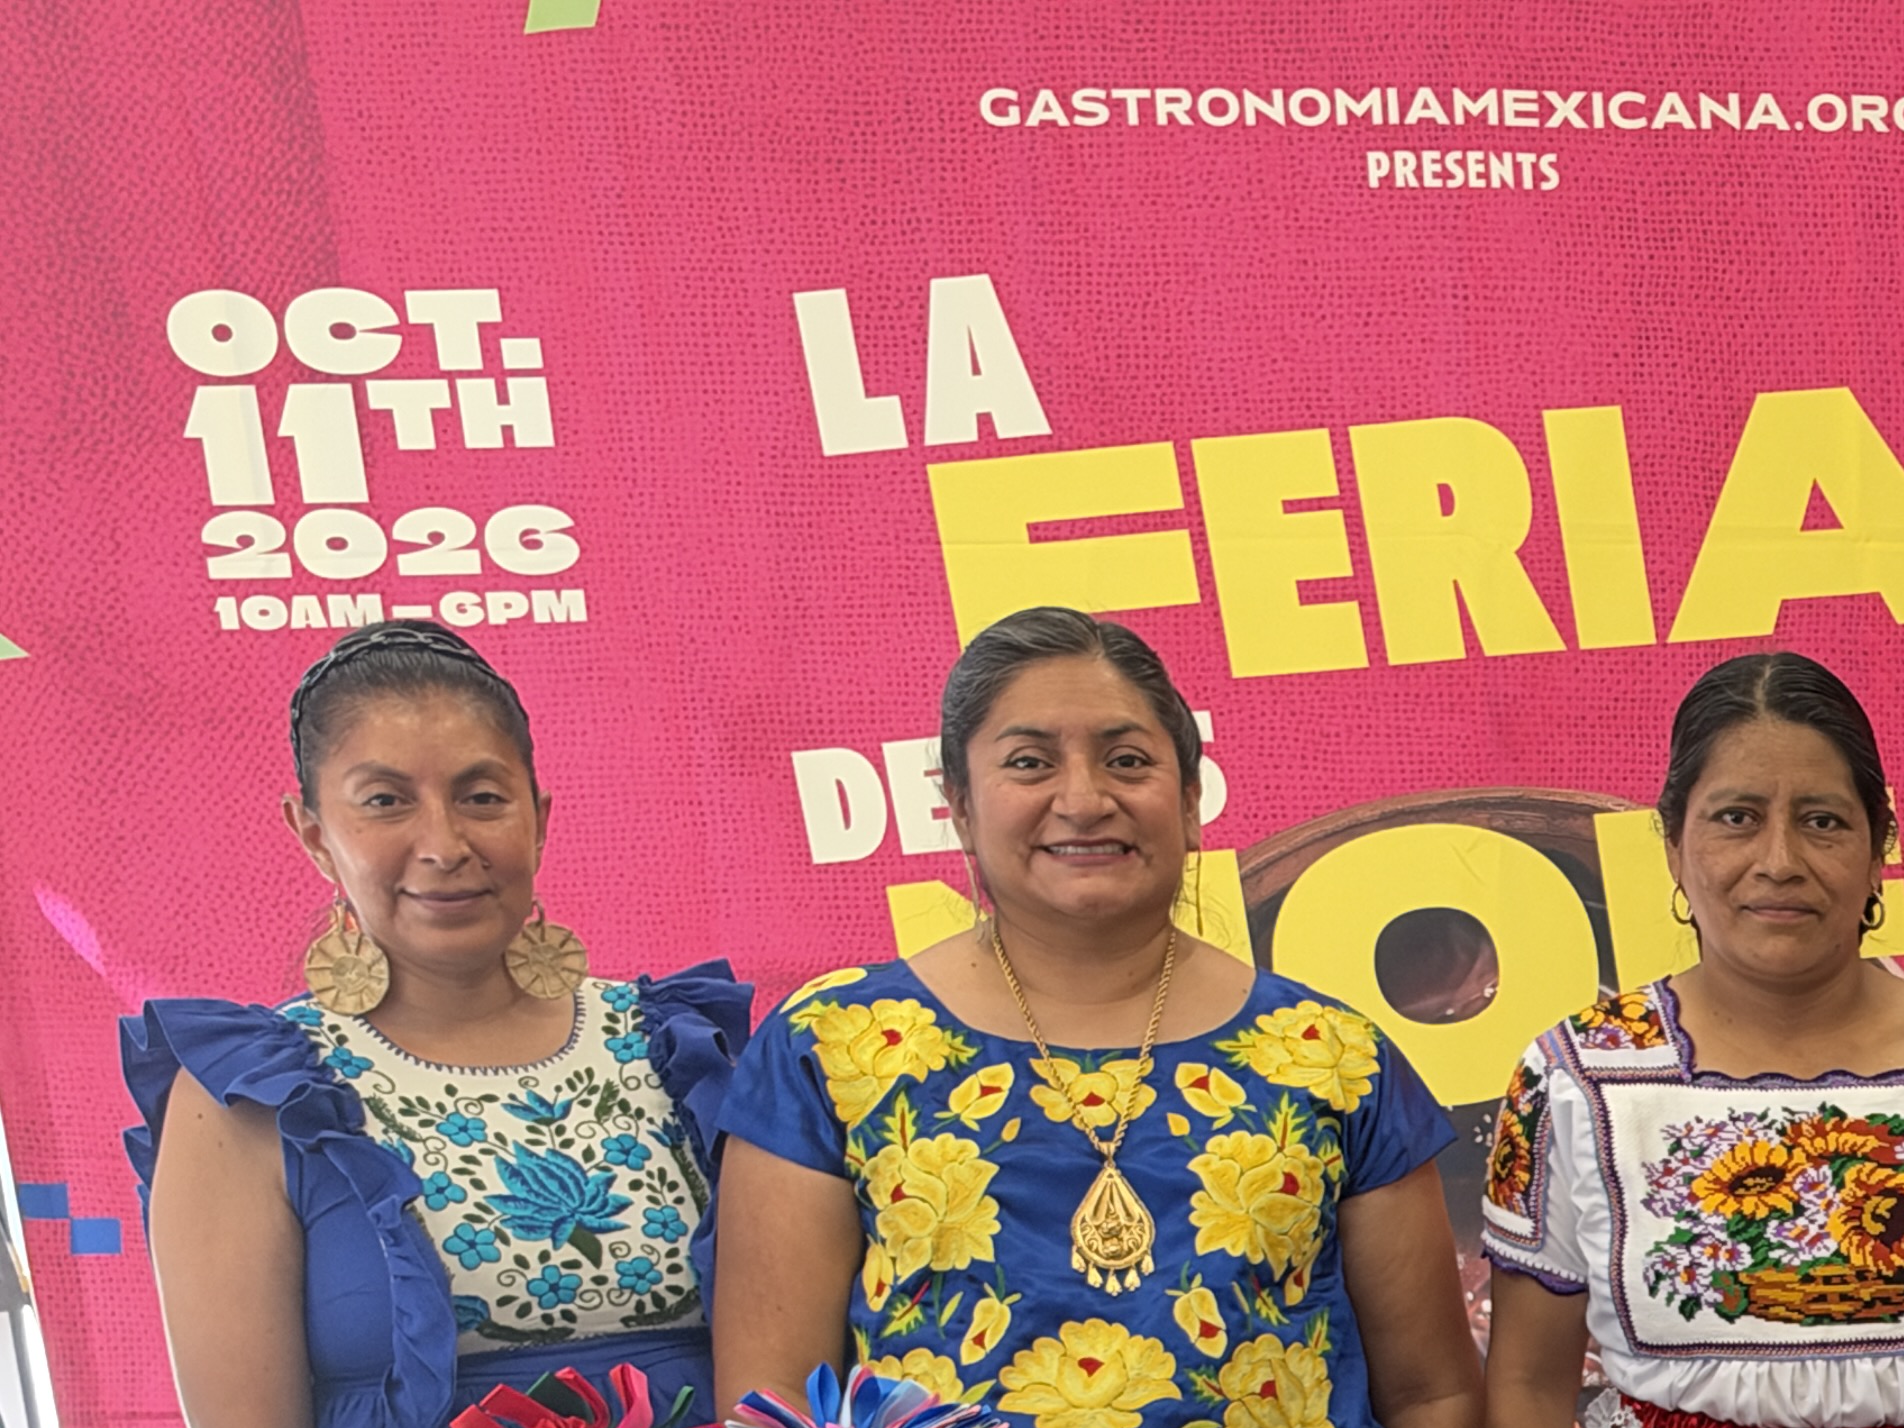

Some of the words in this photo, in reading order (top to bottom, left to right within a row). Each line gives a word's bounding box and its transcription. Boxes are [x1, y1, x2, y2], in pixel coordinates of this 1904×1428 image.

[1367, 151, 1559, 190] PRESENTS
[167, 288, 544, 376] OCT.
[793, 274, 1052, 456] LA
[184, 376, 554, 505] 11TH
[201, 505, 580, 579] 2026
